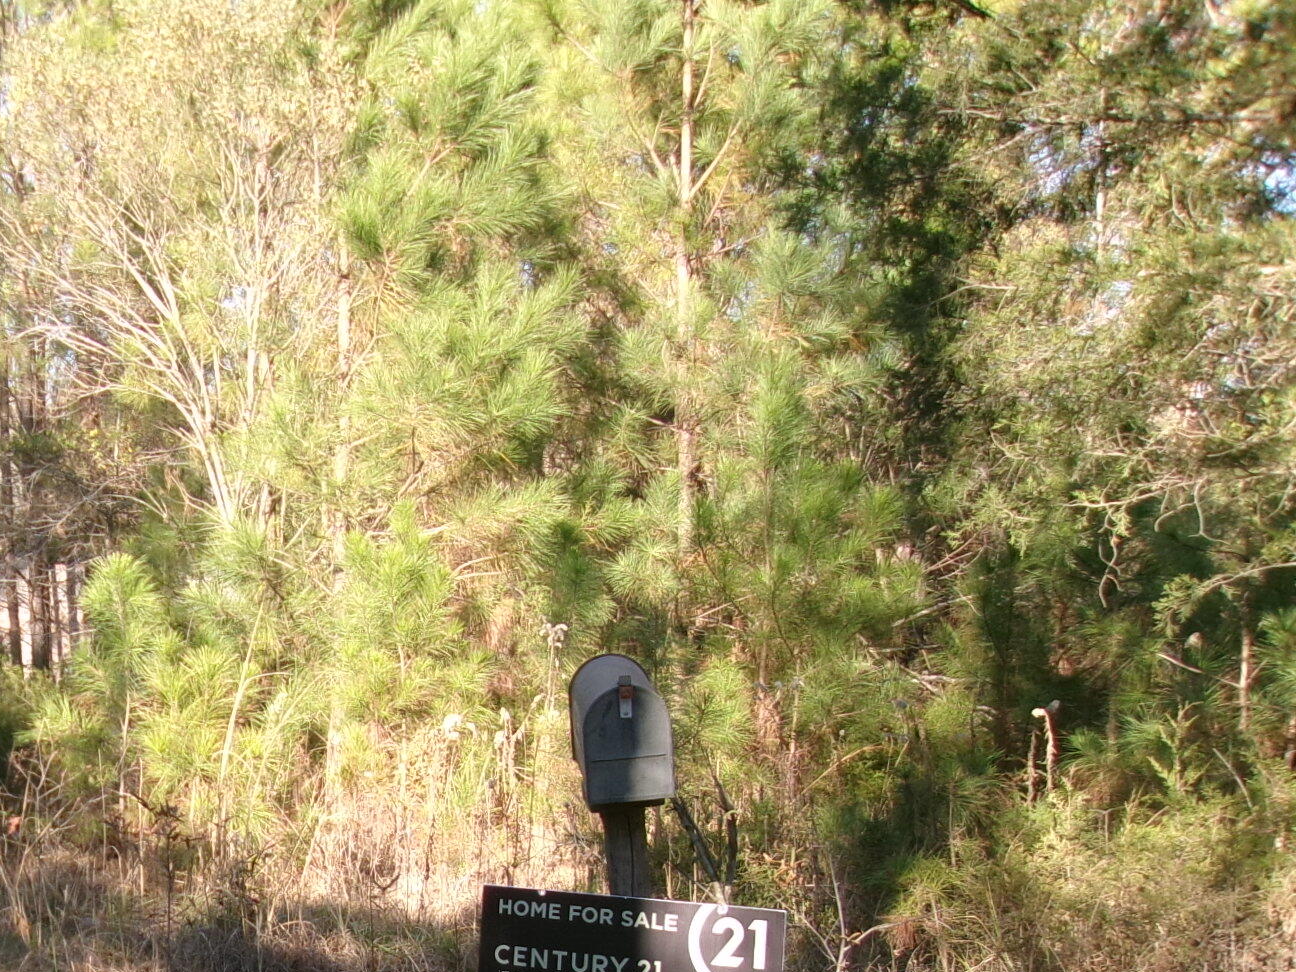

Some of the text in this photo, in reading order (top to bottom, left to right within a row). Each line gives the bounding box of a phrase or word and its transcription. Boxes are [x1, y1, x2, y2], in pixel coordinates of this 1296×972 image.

[498, 898, 678, 932] HOME FOR SALE
